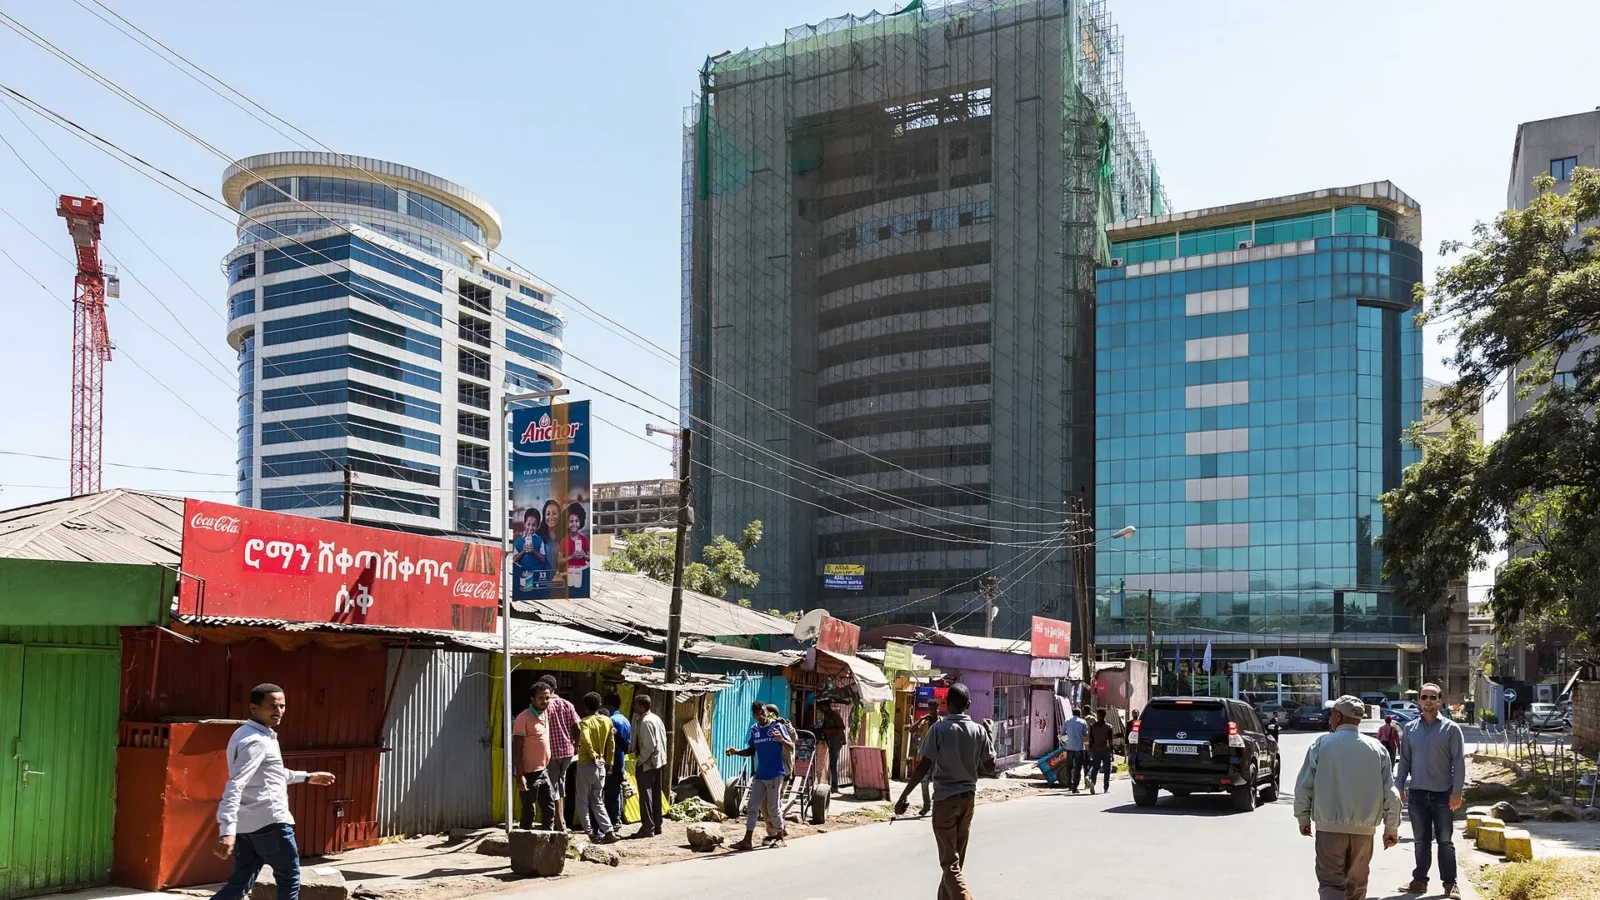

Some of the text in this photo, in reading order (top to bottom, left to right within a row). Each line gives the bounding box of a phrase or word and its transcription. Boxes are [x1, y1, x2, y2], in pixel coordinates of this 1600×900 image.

[520, 418, 579, 444] Anchor
[191, 512, 240, 533] Coca-Cola
[244, 538, 311, 571] ሮማን
[452, 577, 496, 600] Coca-Cola
